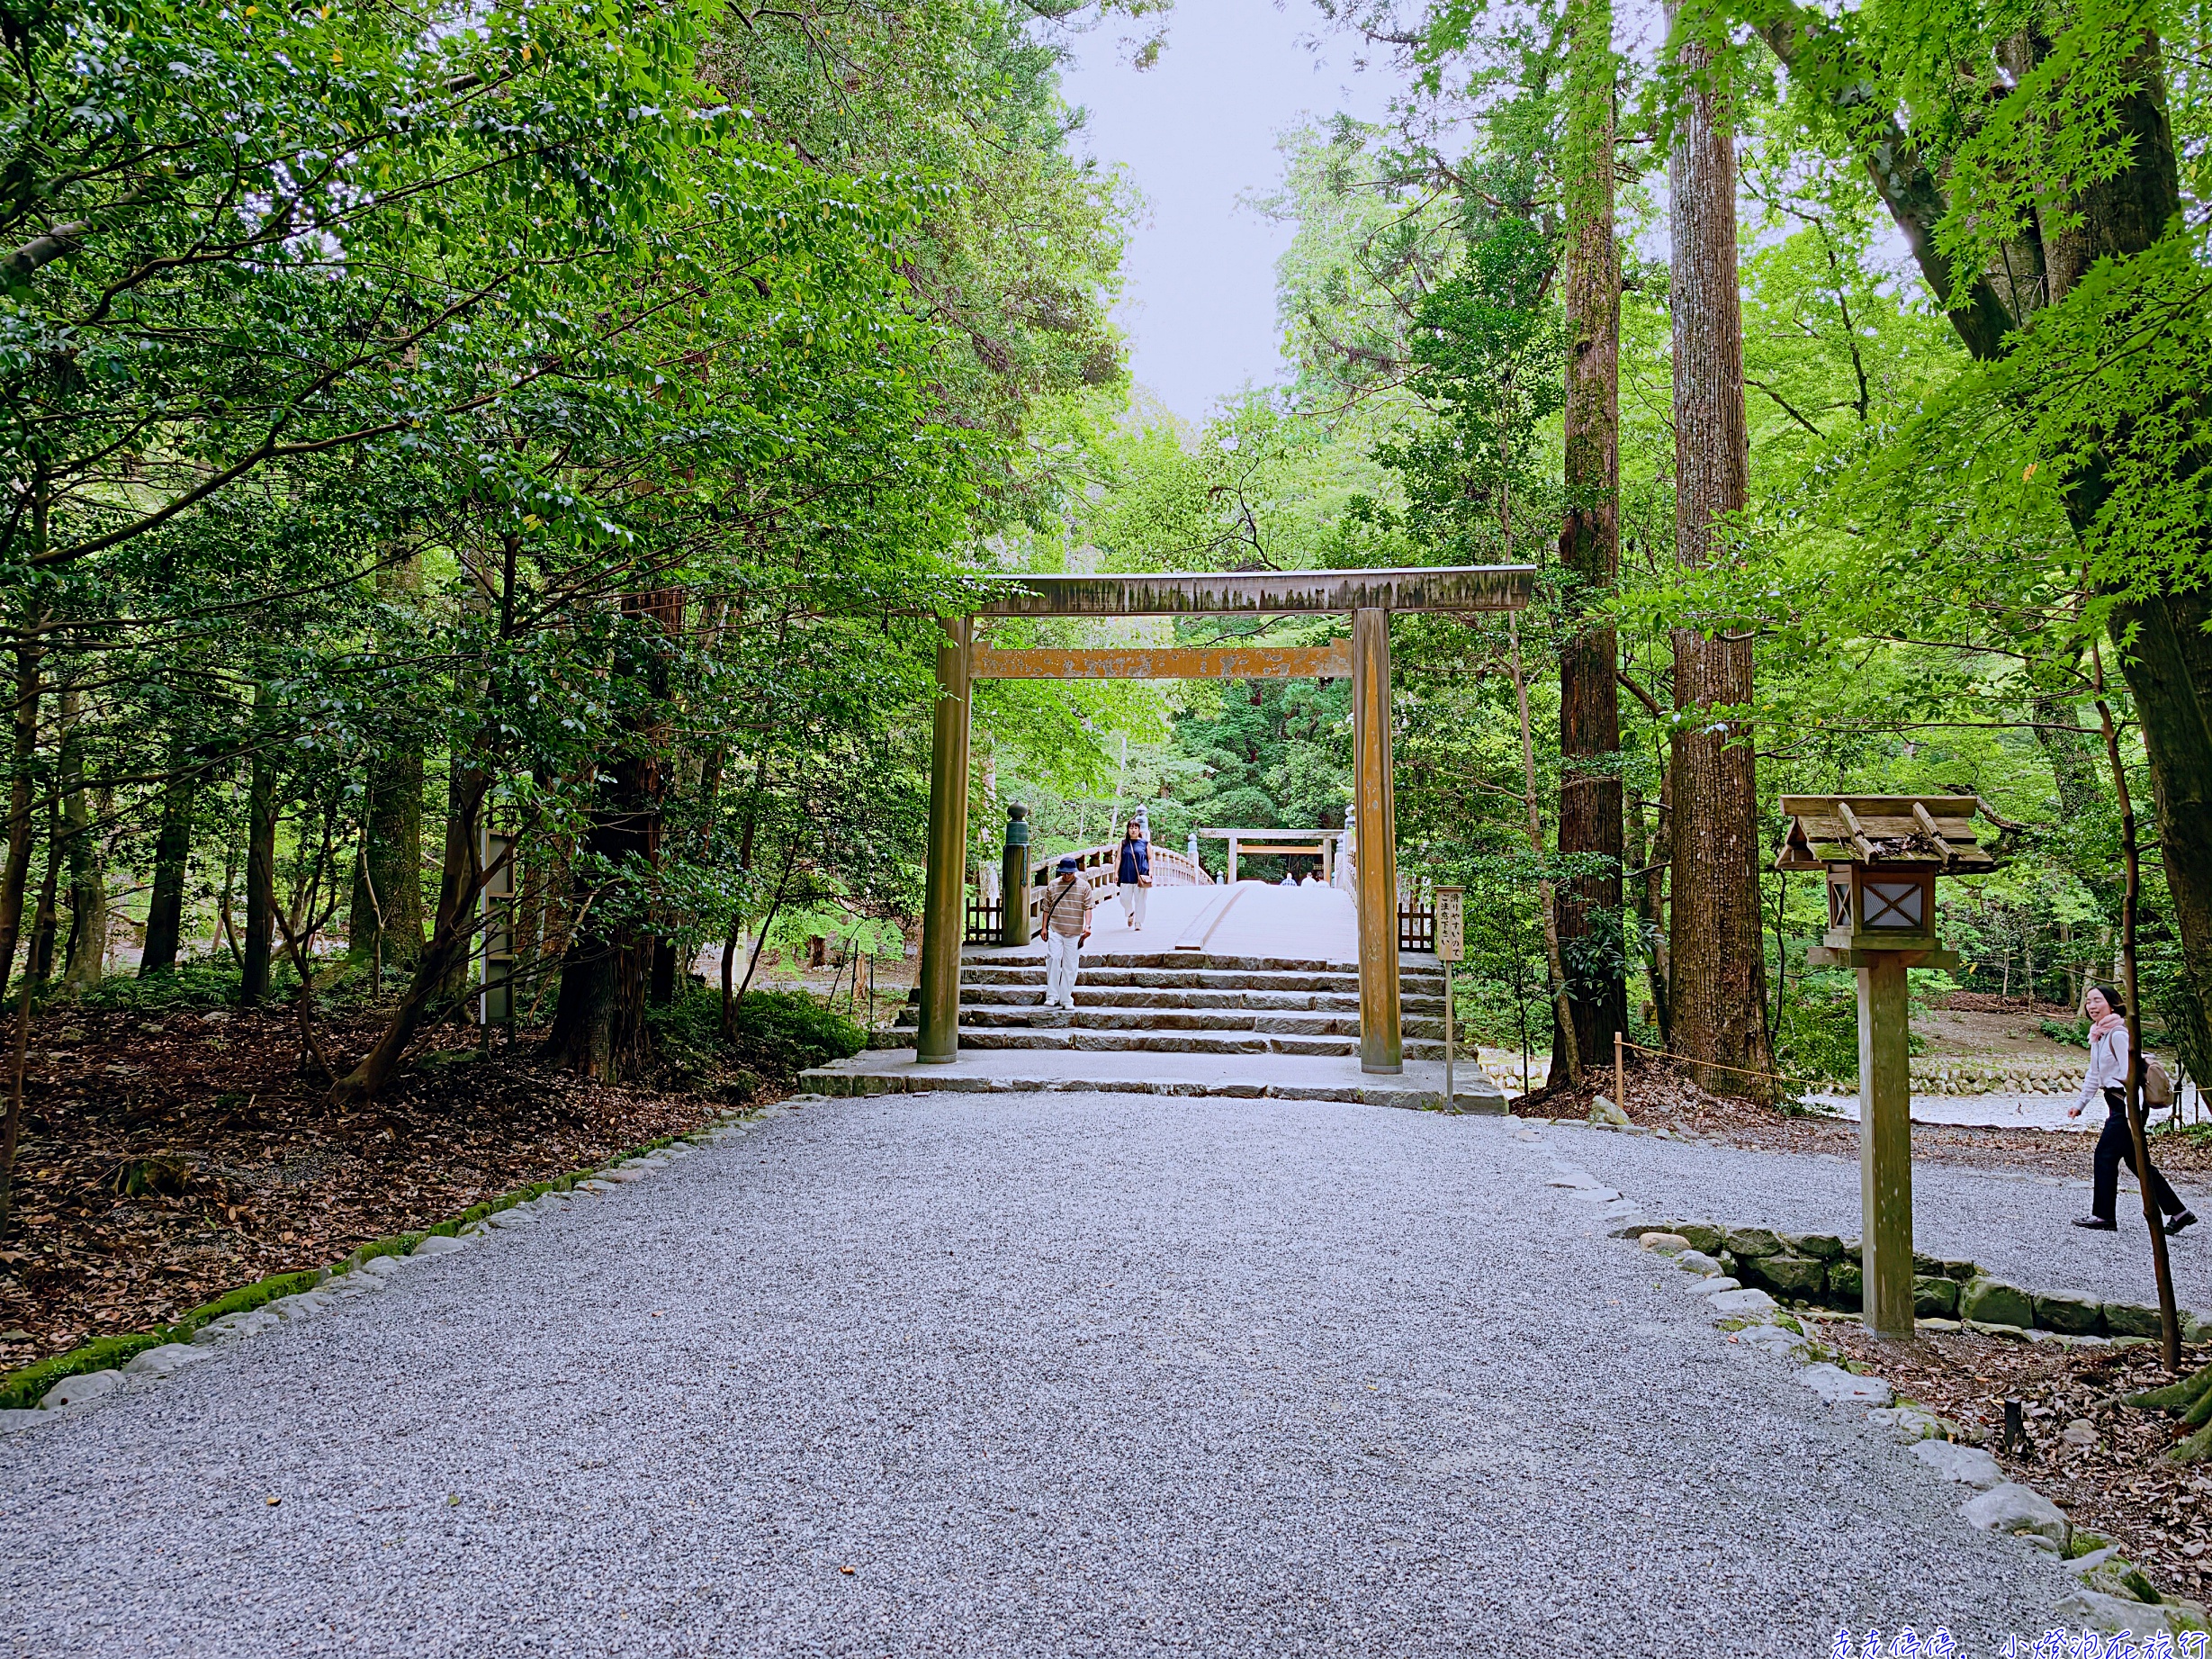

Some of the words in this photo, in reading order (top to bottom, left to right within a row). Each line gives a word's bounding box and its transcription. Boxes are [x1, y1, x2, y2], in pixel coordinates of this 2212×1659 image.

[1441, 894, 1450, 945] ご注意下さい
[1450, 894, 1461, 957] 滑りやすいので
